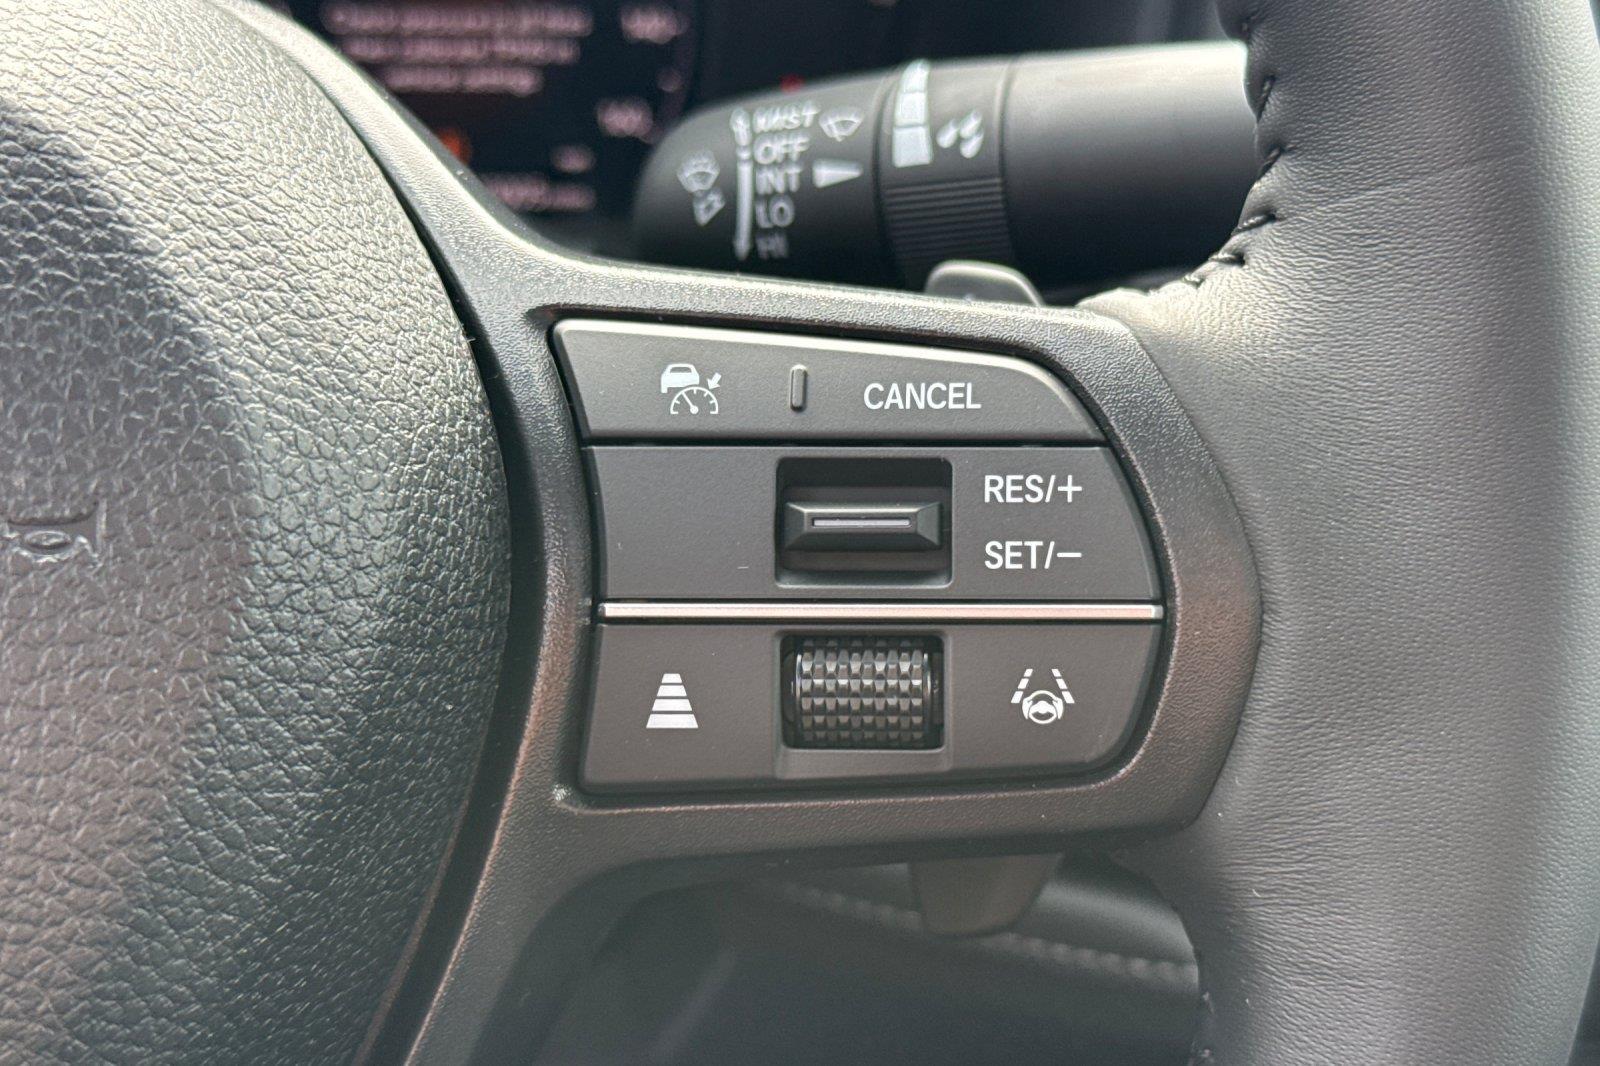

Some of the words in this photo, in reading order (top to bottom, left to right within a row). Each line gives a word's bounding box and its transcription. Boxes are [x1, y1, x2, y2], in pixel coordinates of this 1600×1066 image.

[754, 132, 810, 165] OFF
[755, 165, 802, 194] INT
[755, 194, 795, 228] LO
[863, 382, 982, 410] CANCEL
[984, 474, 1083, 503] RES/+
